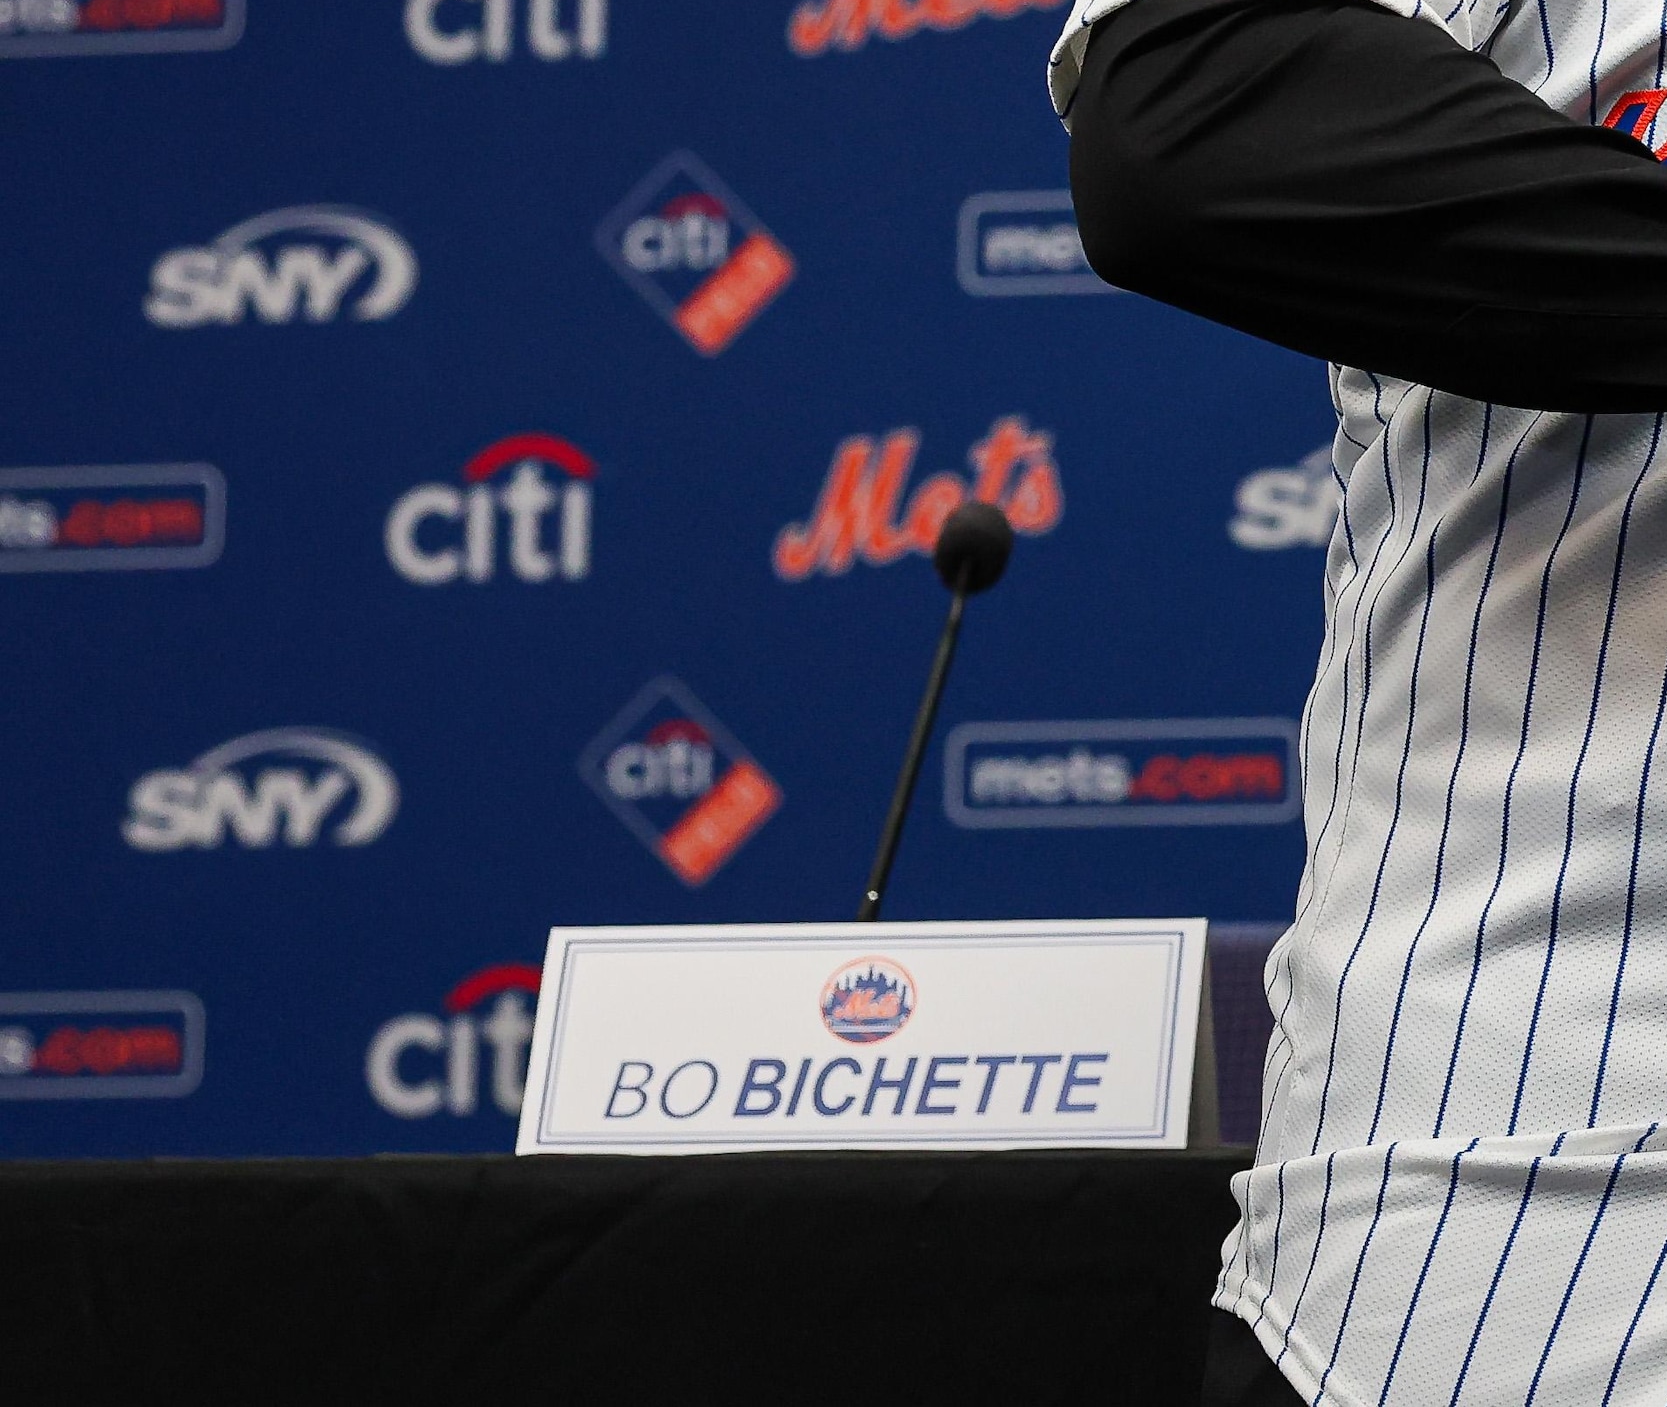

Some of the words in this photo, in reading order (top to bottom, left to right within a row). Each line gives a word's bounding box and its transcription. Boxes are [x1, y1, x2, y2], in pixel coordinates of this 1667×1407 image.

[143, 250, 364, 328] SNY
[384, 459, 592, 586] citi
[771, 414, 1064, 581] Mets
[121, 770, 342, 851] SNY
[365, 990, 536, 1120] cit
[604, 1059, 719, 1129] BO
[733, 1052, 1110, 1117] BICHETTE
